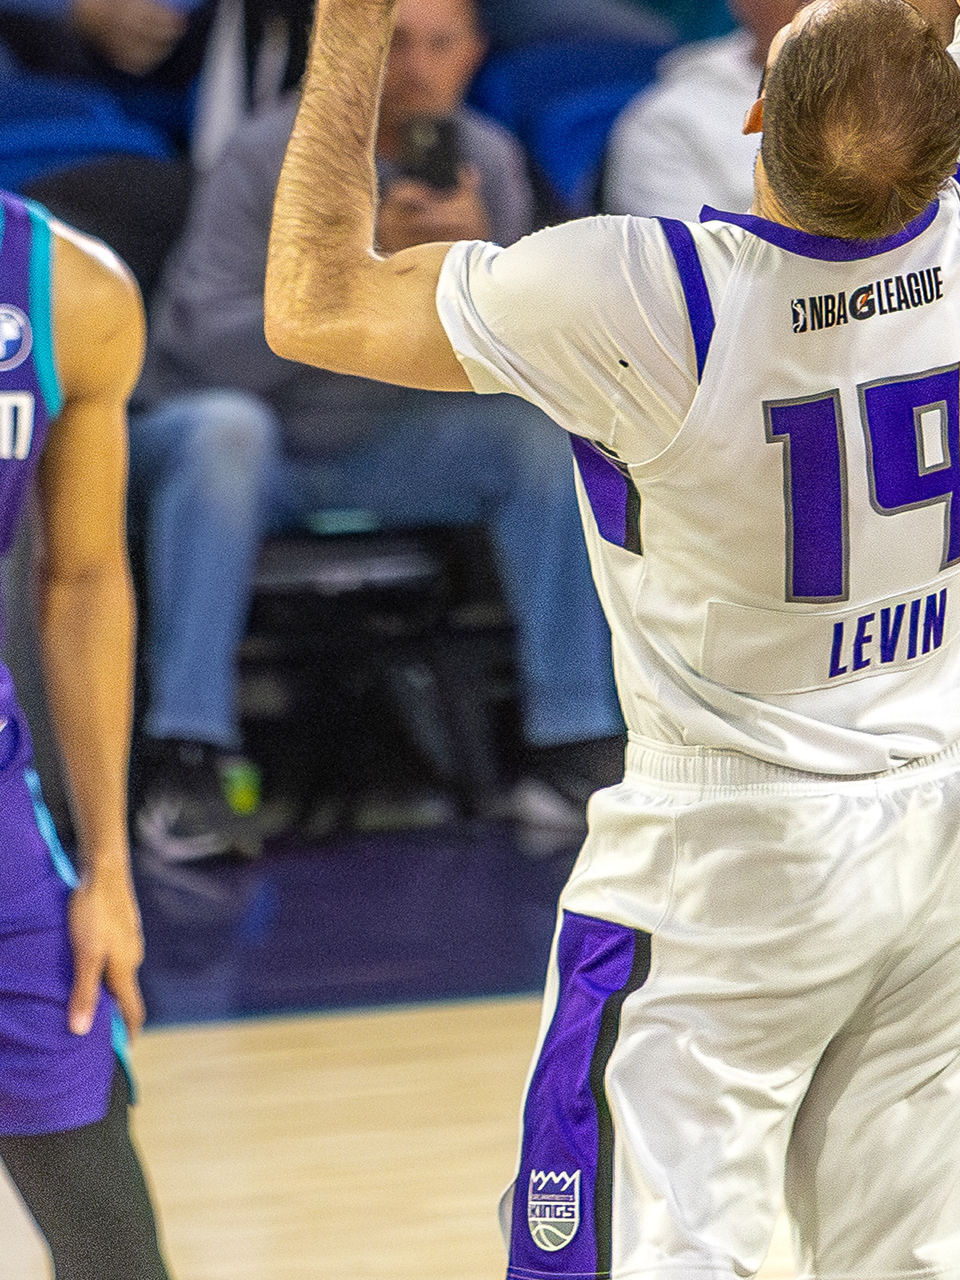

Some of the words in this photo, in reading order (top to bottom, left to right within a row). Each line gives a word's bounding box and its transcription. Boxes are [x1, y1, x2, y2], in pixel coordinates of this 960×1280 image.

[808, 291, 849, 331] NBA
[848, 283, 877, 321] G
[876, 266, 944, 316] LEAGUE
[828, 587, 948, 679] LEVIN
[529, 1204, 575, 1219] KINGS
